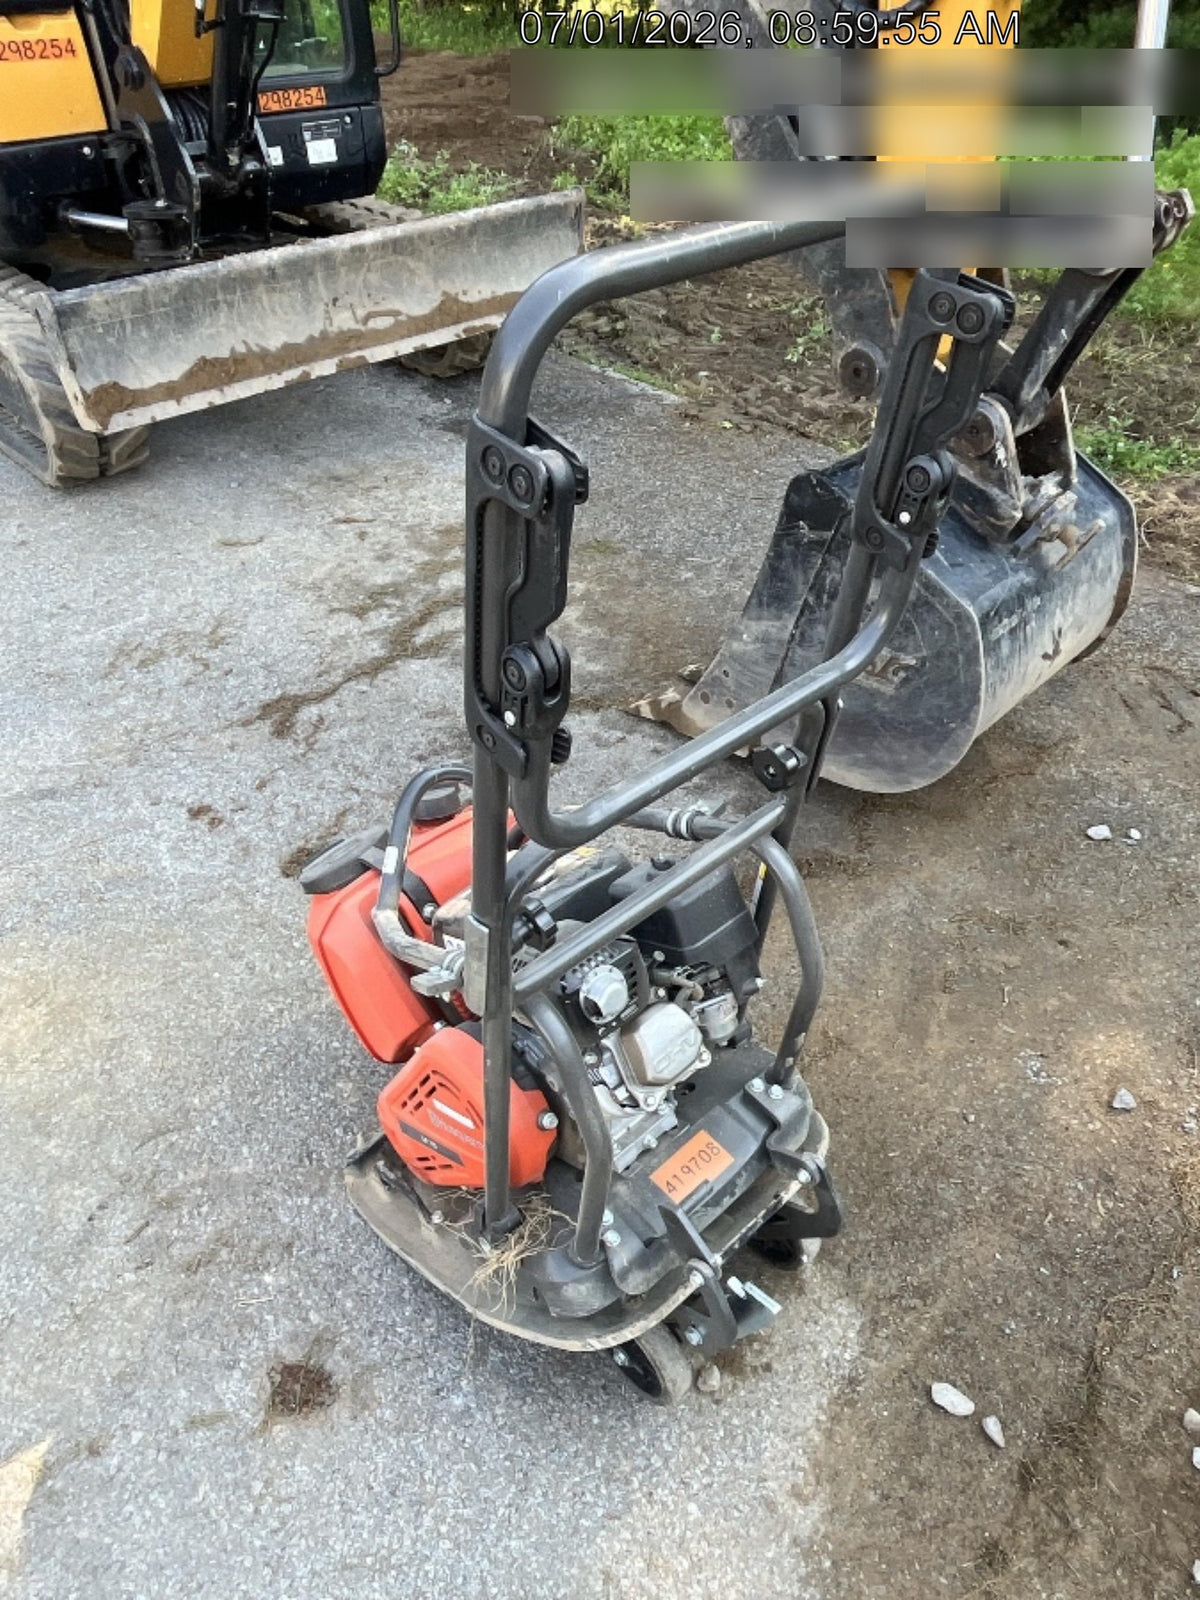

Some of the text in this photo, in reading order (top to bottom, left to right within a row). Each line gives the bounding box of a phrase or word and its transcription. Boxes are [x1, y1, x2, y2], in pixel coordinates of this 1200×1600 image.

[0, 38, 77, 61] 298254
[261, 87, 325, 111] 298254
[665, 1141, 721, 1194] 419708
